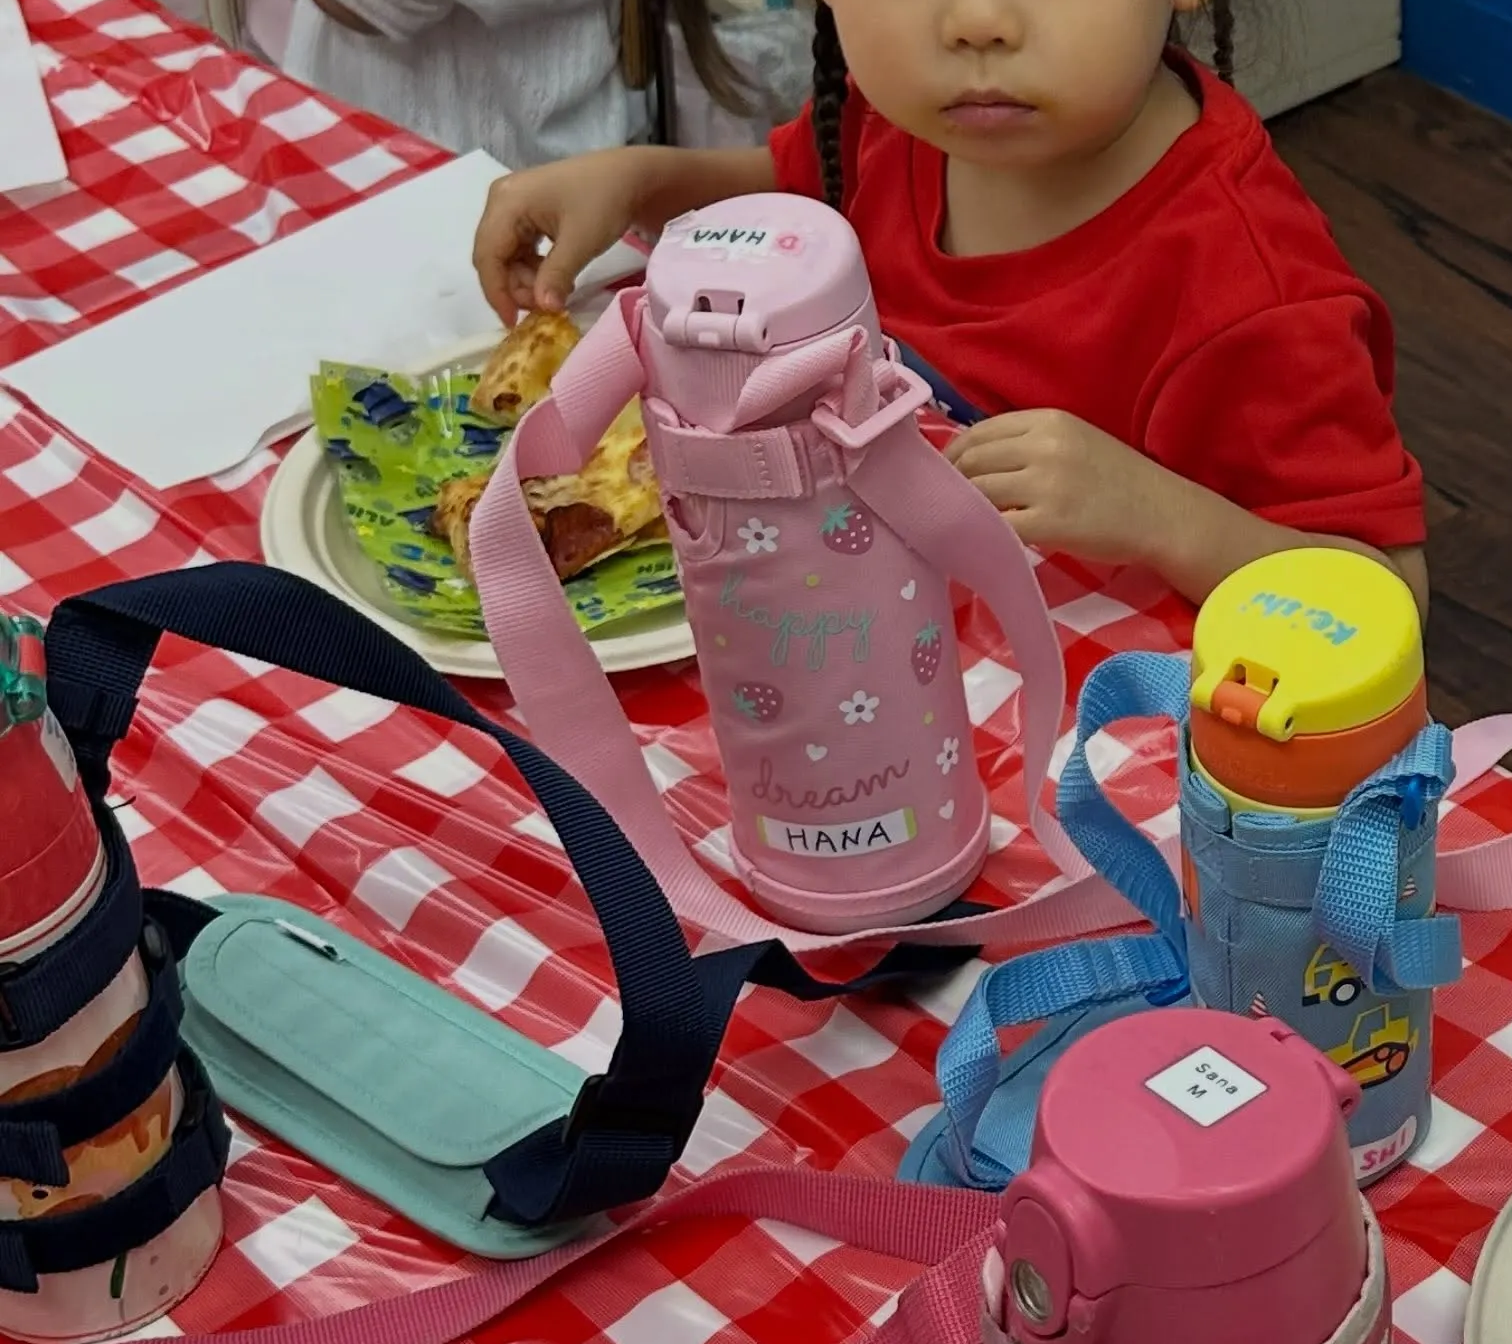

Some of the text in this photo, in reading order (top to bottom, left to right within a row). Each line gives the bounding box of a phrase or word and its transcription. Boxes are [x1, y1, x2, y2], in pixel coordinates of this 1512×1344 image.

[693, 229, 766, 245] HANA
[719, 561, 879, 671] happy
[751, 758, 911, 809] dream
[786, 821, 892, 852] HANA
[1187, 1084, 1207, 1098] M
[1195, 1062, 1239, 1095] Sana
